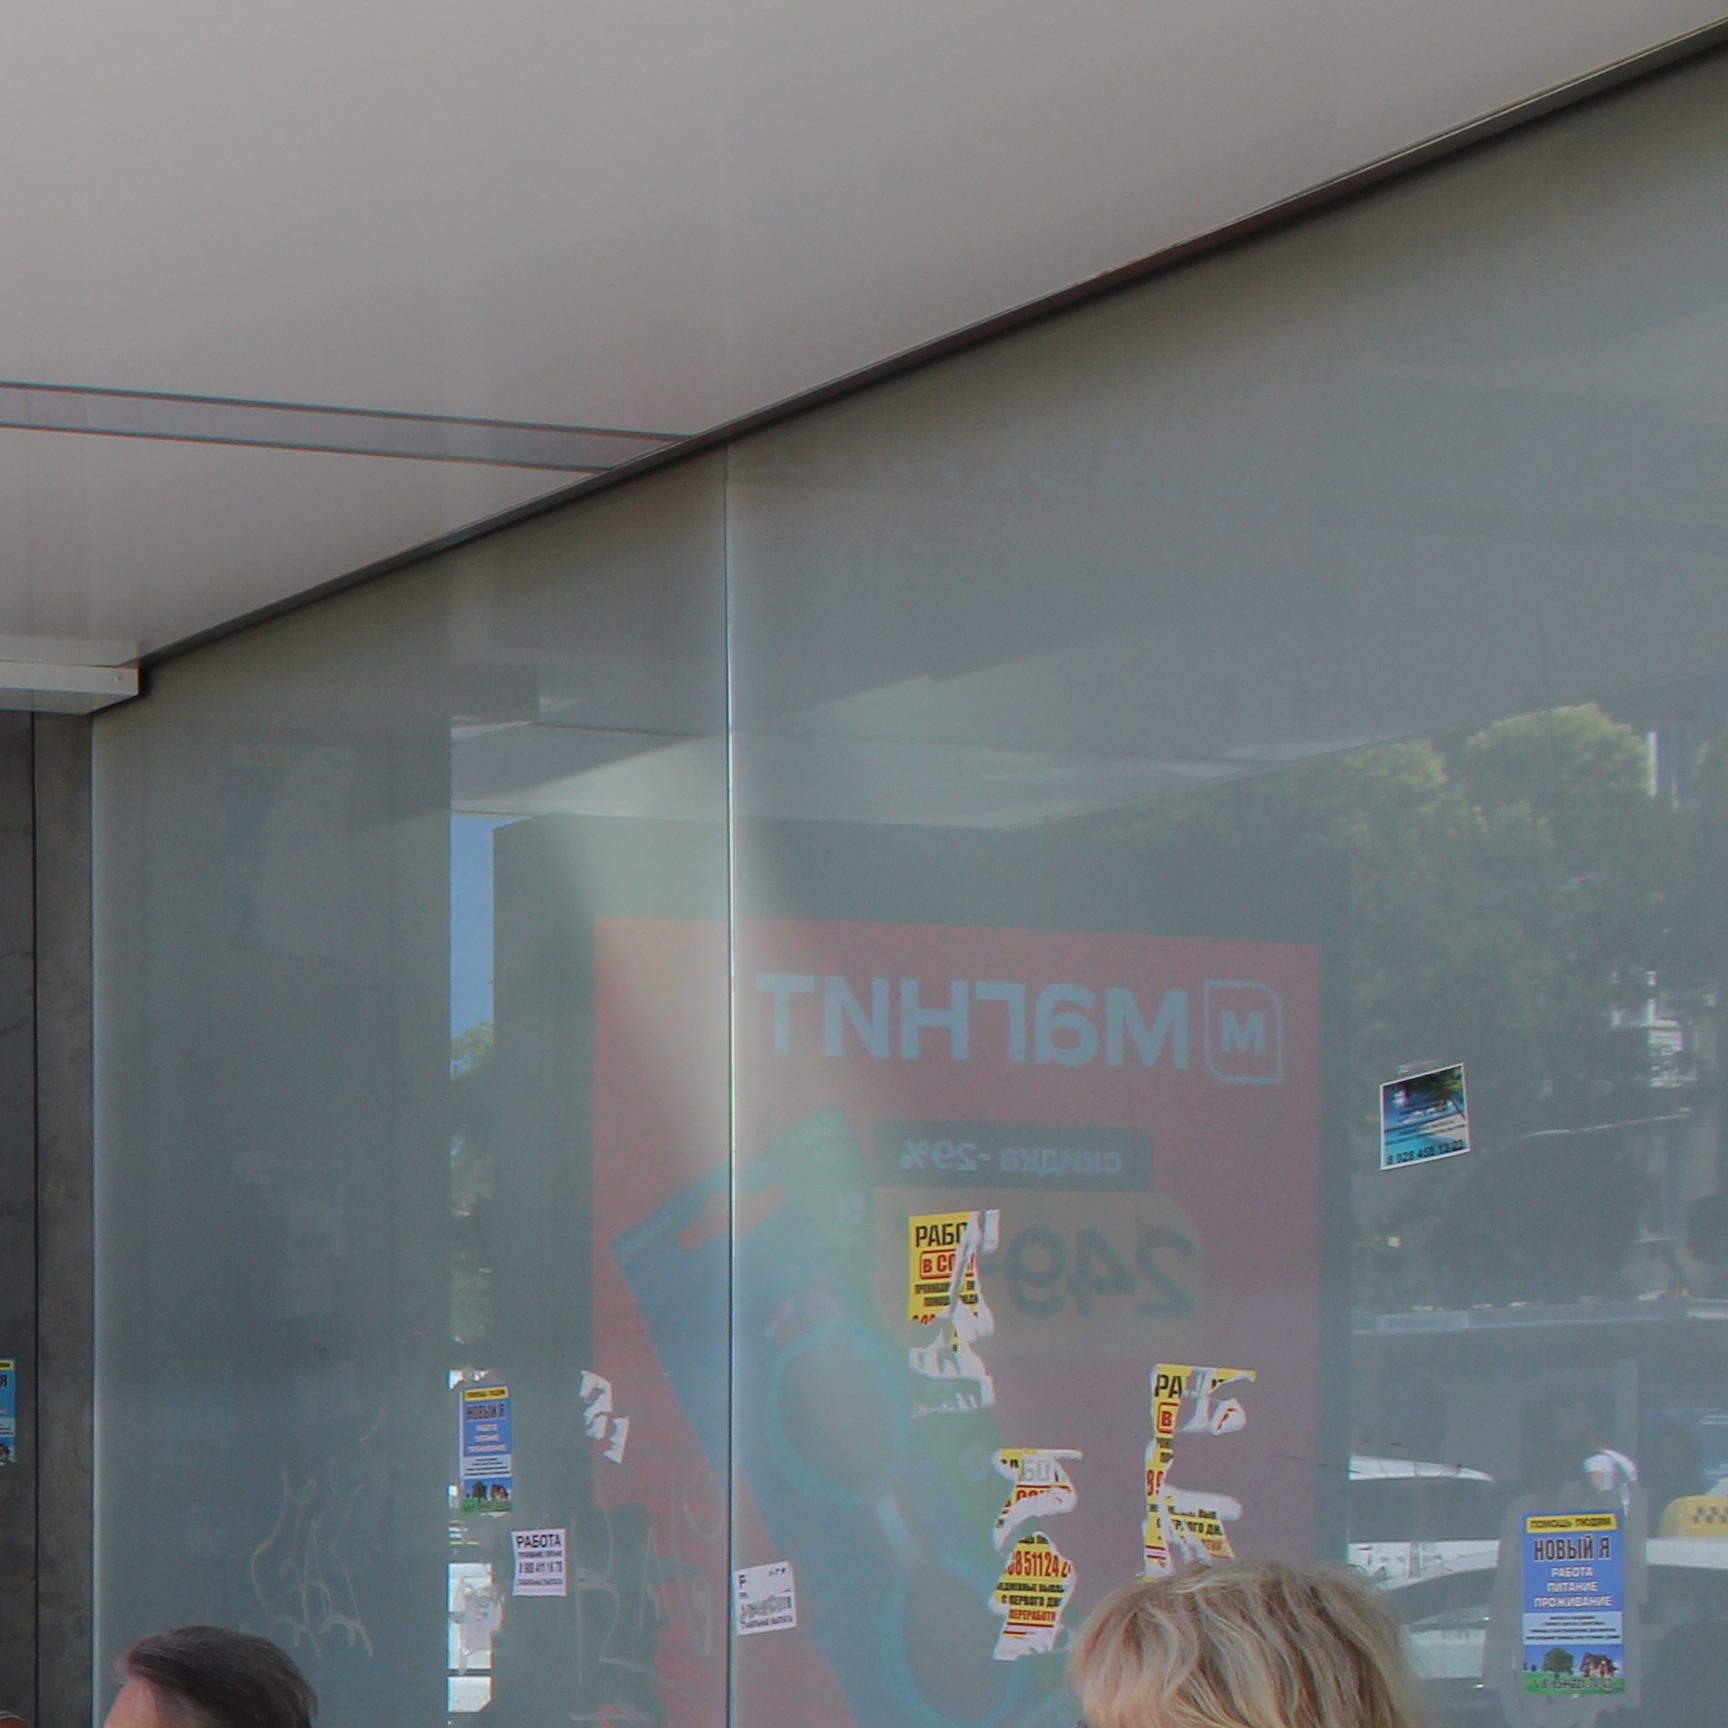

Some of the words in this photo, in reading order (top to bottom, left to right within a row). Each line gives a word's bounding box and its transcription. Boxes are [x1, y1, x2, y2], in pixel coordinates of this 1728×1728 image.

[915, 1221, 968, 1248] РАБО
[1530, 1520, 1573, 1529] ПОМОЩЬ
[1575, 1517, 1612, 1527] ЛЮДЯМ
[516, 1534, 561, 1548] РАБОТА
[1533, 1536, 1594, 1562] НОВЫЙ
[1599, 1537, 1611, 1559] Я
[1551, 1565, 1594, 1578] РАБОТА
[1547, 1581, 1599, 1592] ПИТАНИЕ
[1533, 1596, 1612, 1608] ПРОЖИВАНИЕ
